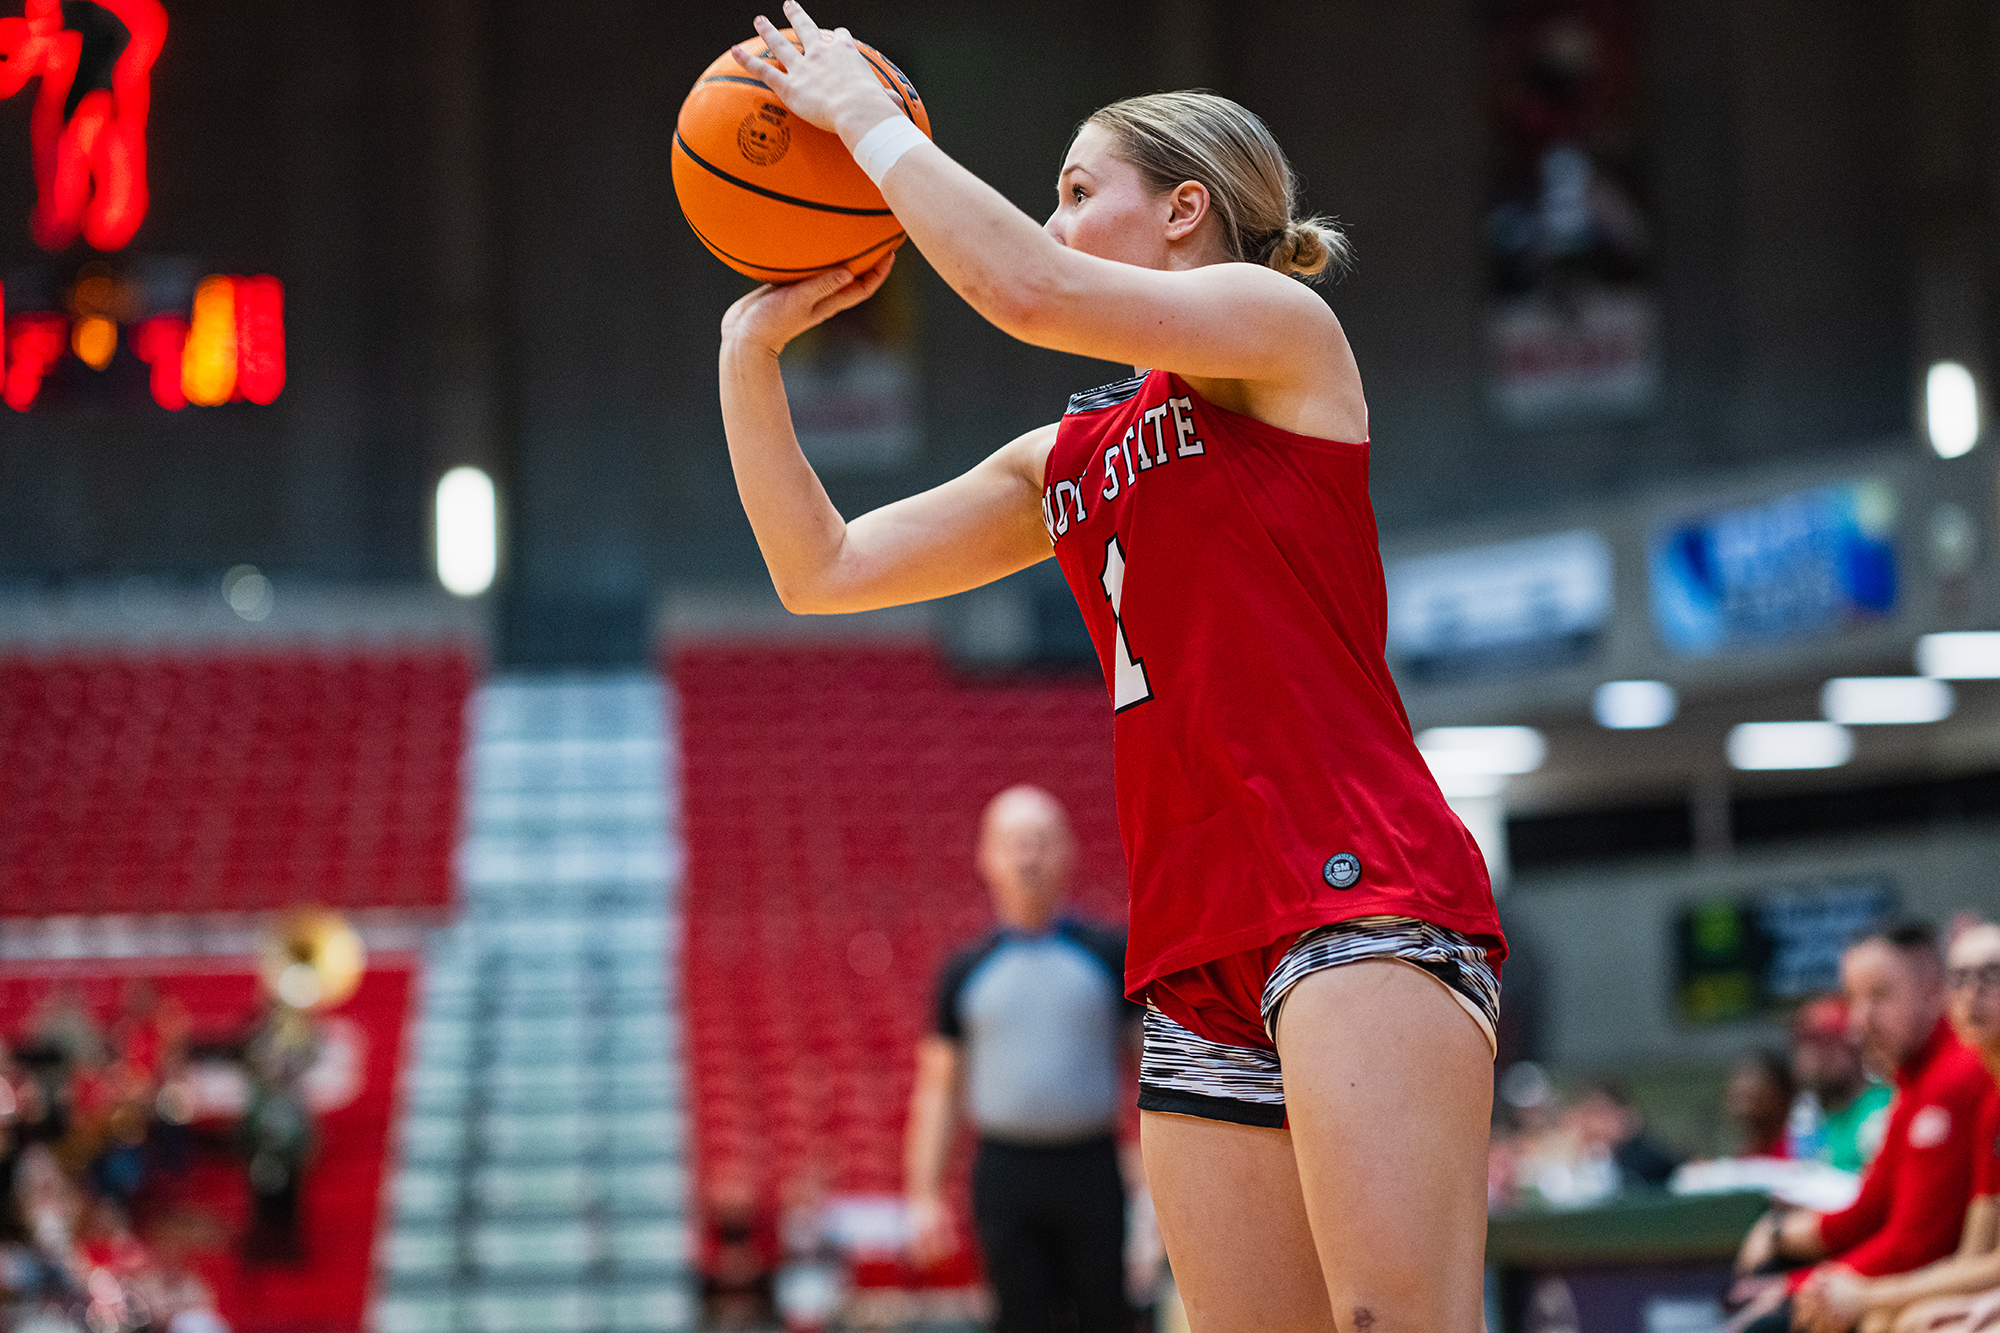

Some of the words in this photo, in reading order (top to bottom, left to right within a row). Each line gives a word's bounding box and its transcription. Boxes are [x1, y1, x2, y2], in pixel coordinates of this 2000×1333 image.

[1102, 394, 1206, 503] STATE
[1098, 531, 1155, 716] 1
[1333, 861, 1351, 872] SM
